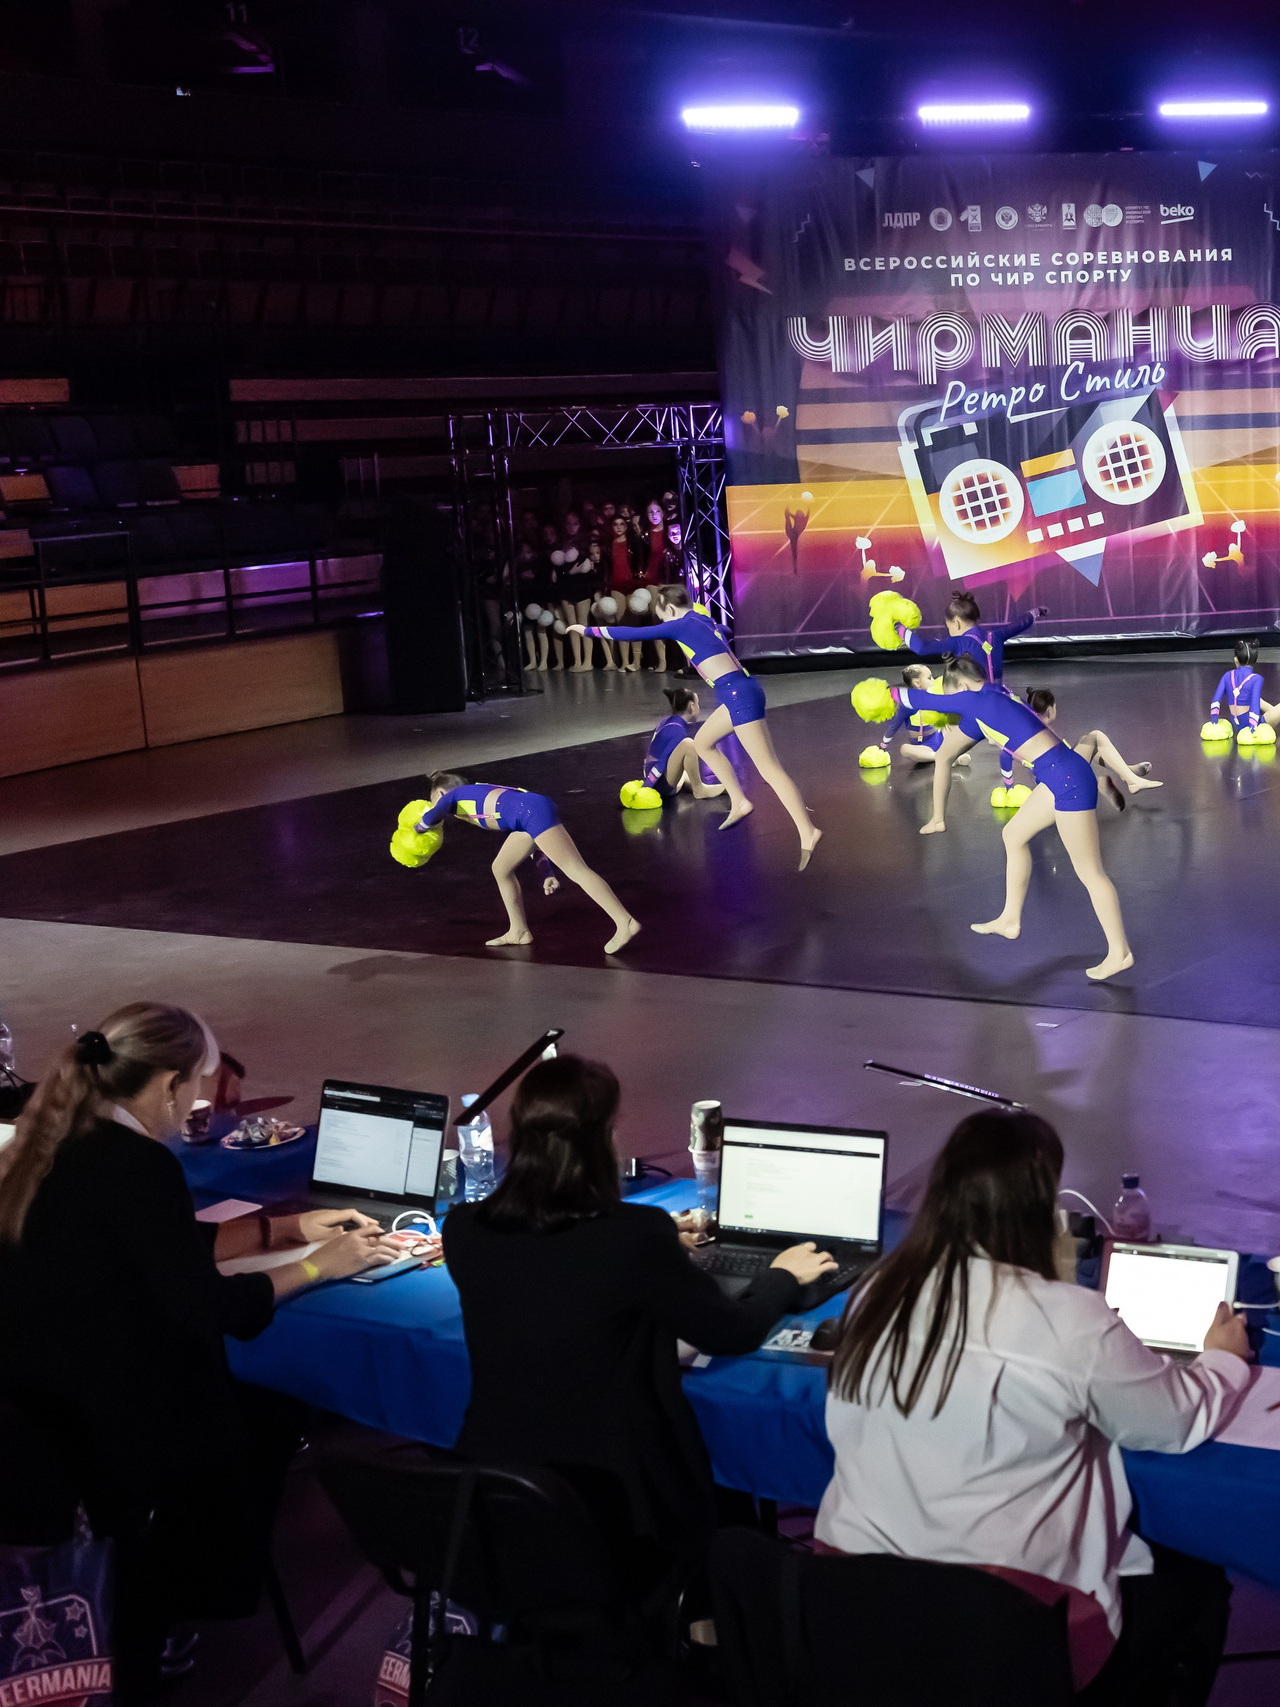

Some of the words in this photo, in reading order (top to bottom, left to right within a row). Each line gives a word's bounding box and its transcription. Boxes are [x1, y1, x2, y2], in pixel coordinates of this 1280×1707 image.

[225, 1, 248, 24] 11
[457, 26, 480, 49] 12
[882, 212, 921, 229] ЛДПР
[1159, 203, 1195, 217] beko
[844, 251, 1041, 271] ВСЕРОССИЙСКИЕ
[1051, 247, 1234, 267] СОРЕВНОВАНИЯ
[950, 272, 982, 287] ПО
[990, 272, 1036, 287] ЧИР
[1045, 268, 1133, 286] СПОРТУ
[939, 380, 1047, 423] Ретро
[1060, 360, 1167, 401] Стиль
